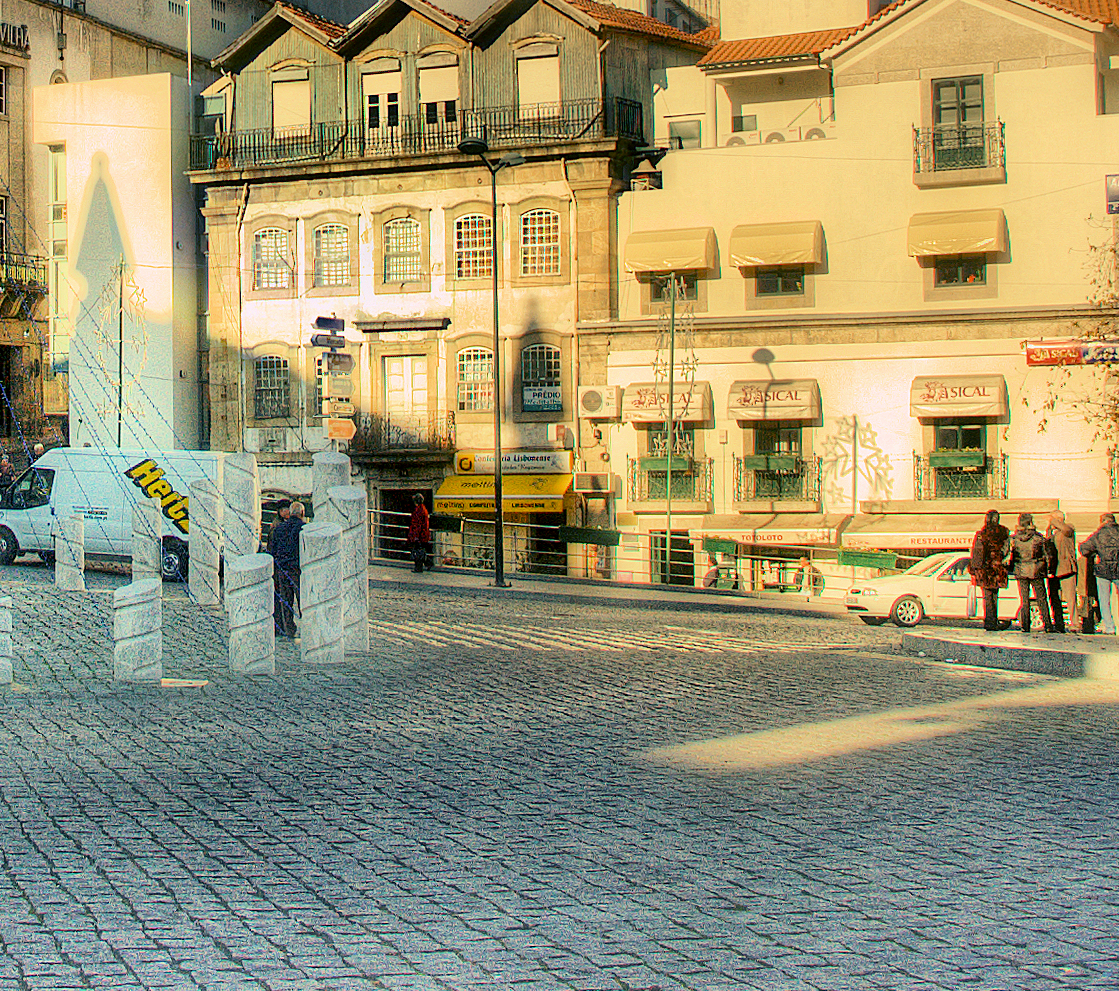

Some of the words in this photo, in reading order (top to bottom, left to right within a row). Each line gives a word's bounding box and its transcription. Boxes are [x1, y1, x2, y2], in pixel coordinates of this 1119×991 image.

[659, 392, 694, 404] SIAL
[765, 390, 802, 402] SICAL
[950, 386, 991, 398] SICAL
[741, 534, 783, 542] TOTOLOTO
